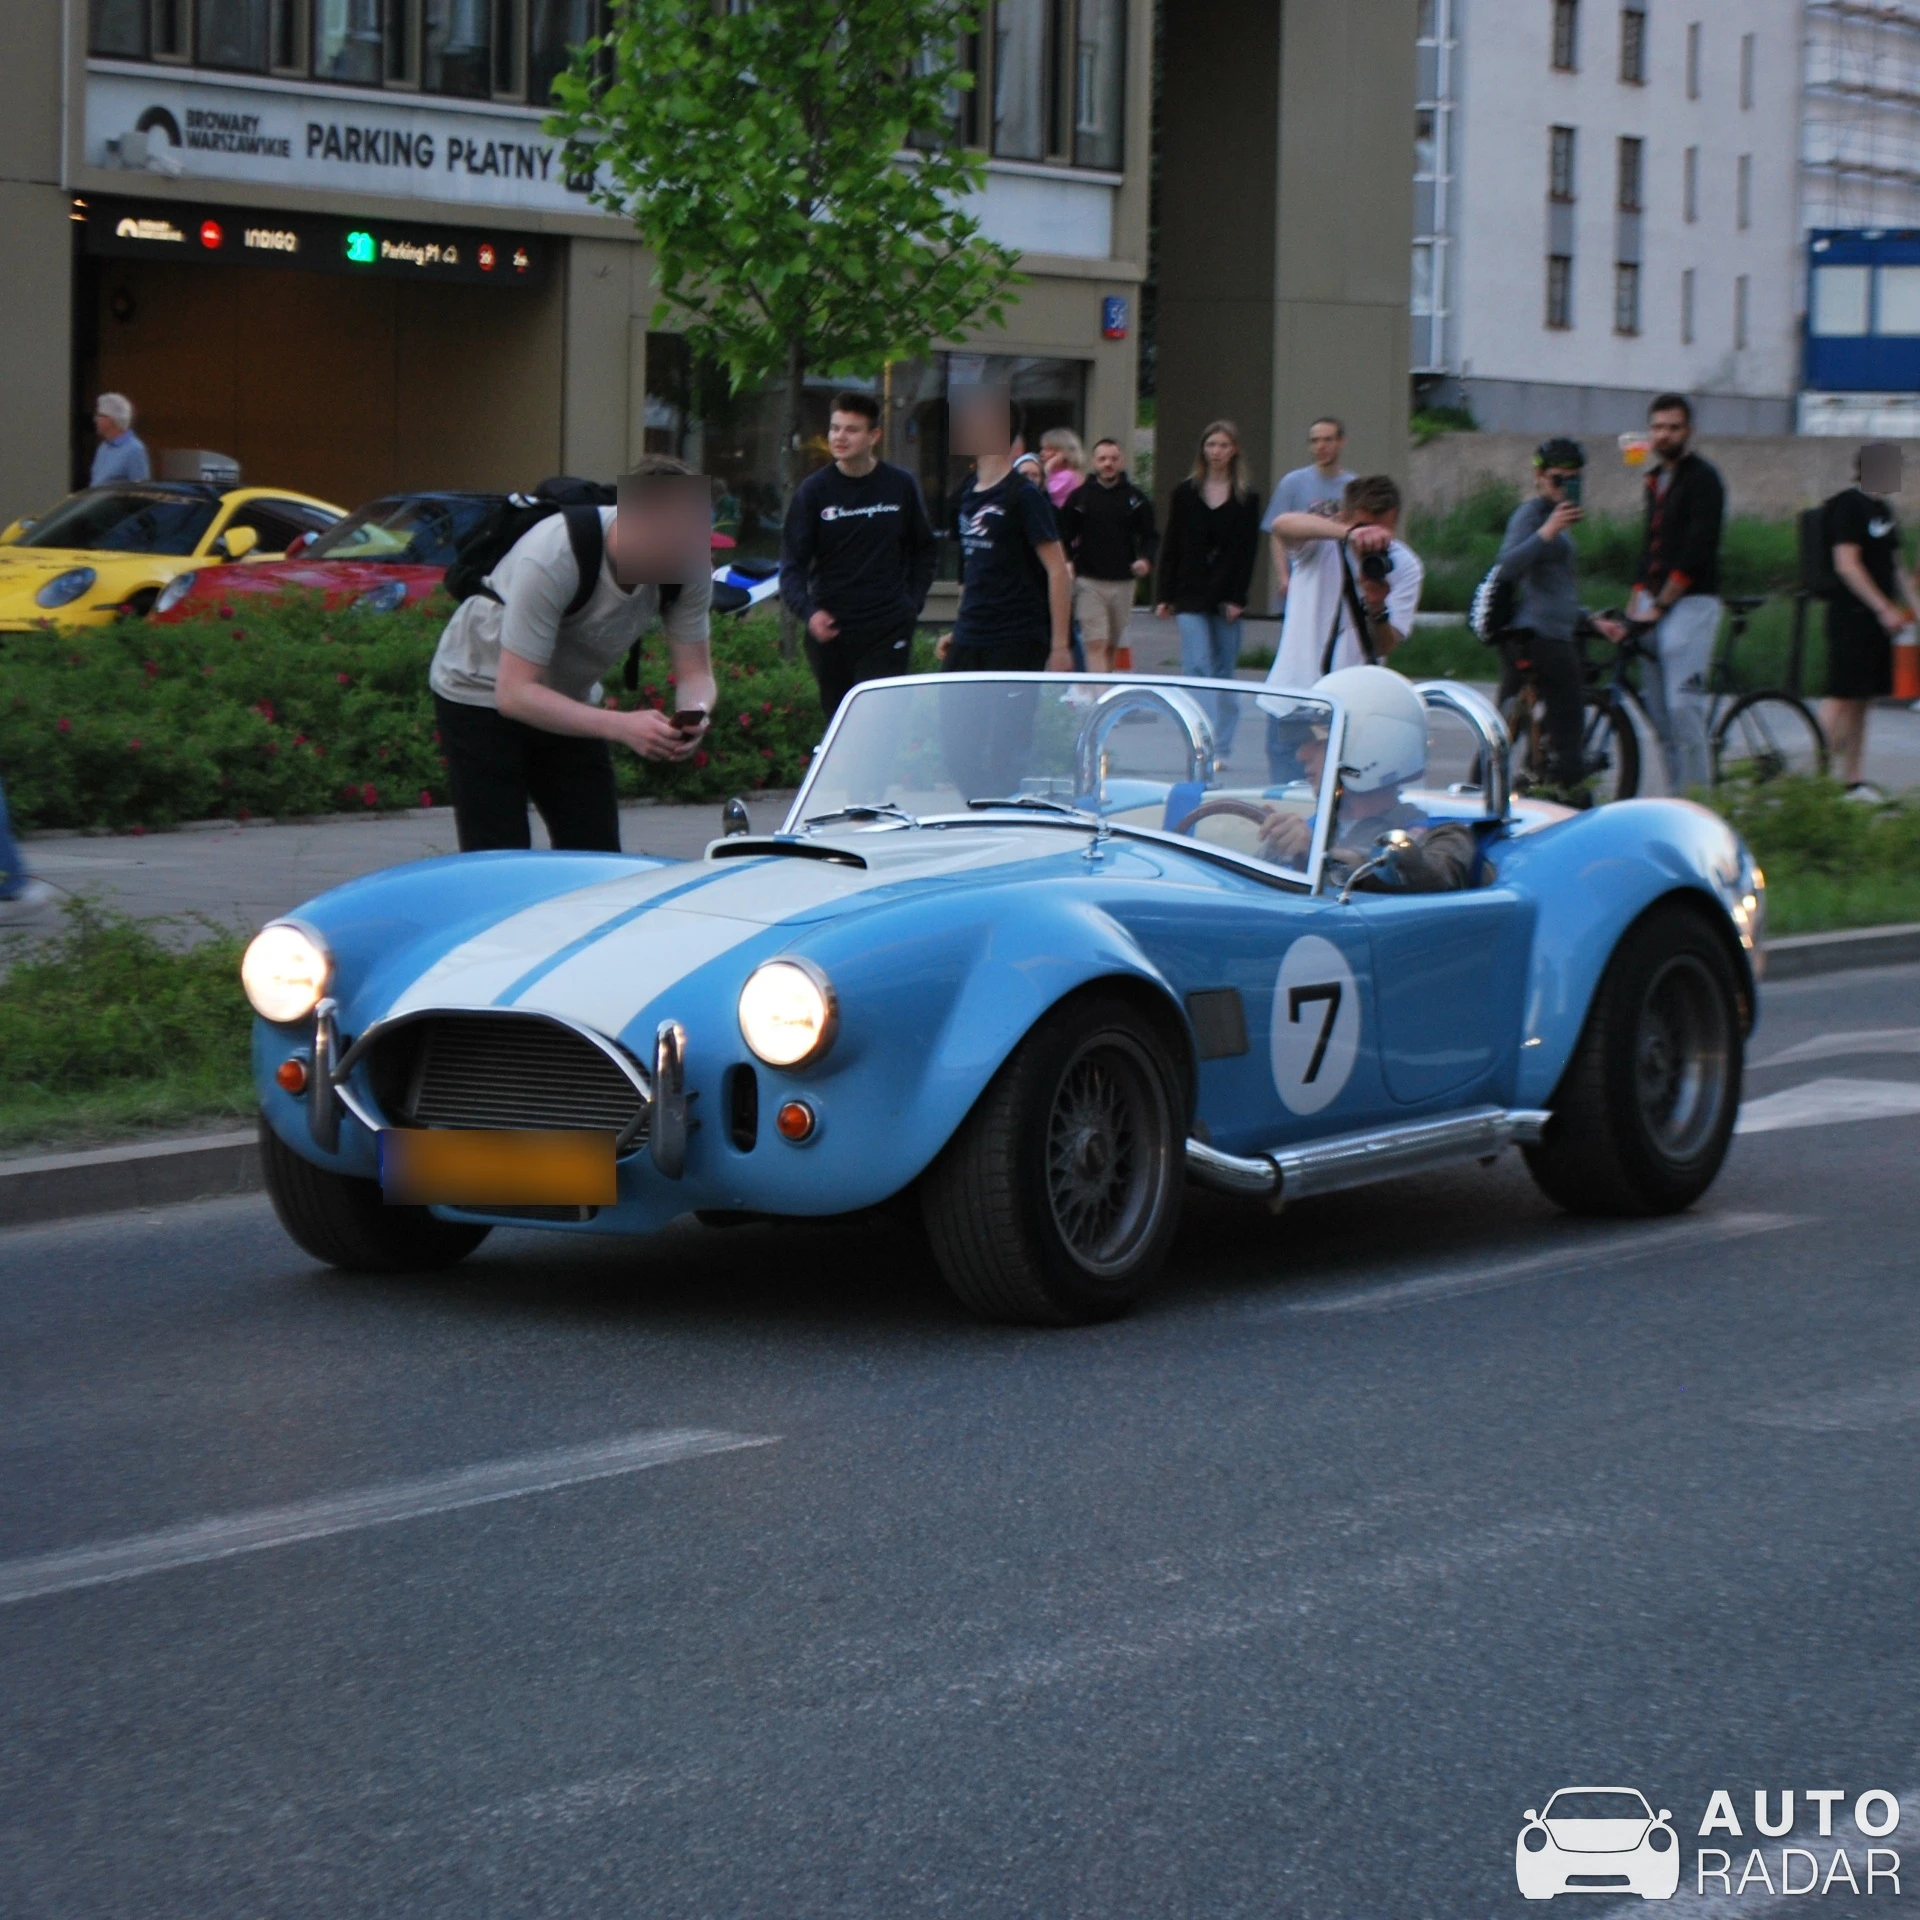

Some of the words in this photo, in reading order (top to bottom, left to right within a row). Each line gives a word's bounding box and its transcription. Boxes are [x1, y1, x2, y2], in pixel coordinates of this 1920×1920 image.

[306, 123, 434, 168] PARKING
[447, 138, 554, 180] PŁATNY
[1288, 981, 1342, 1085] 7
